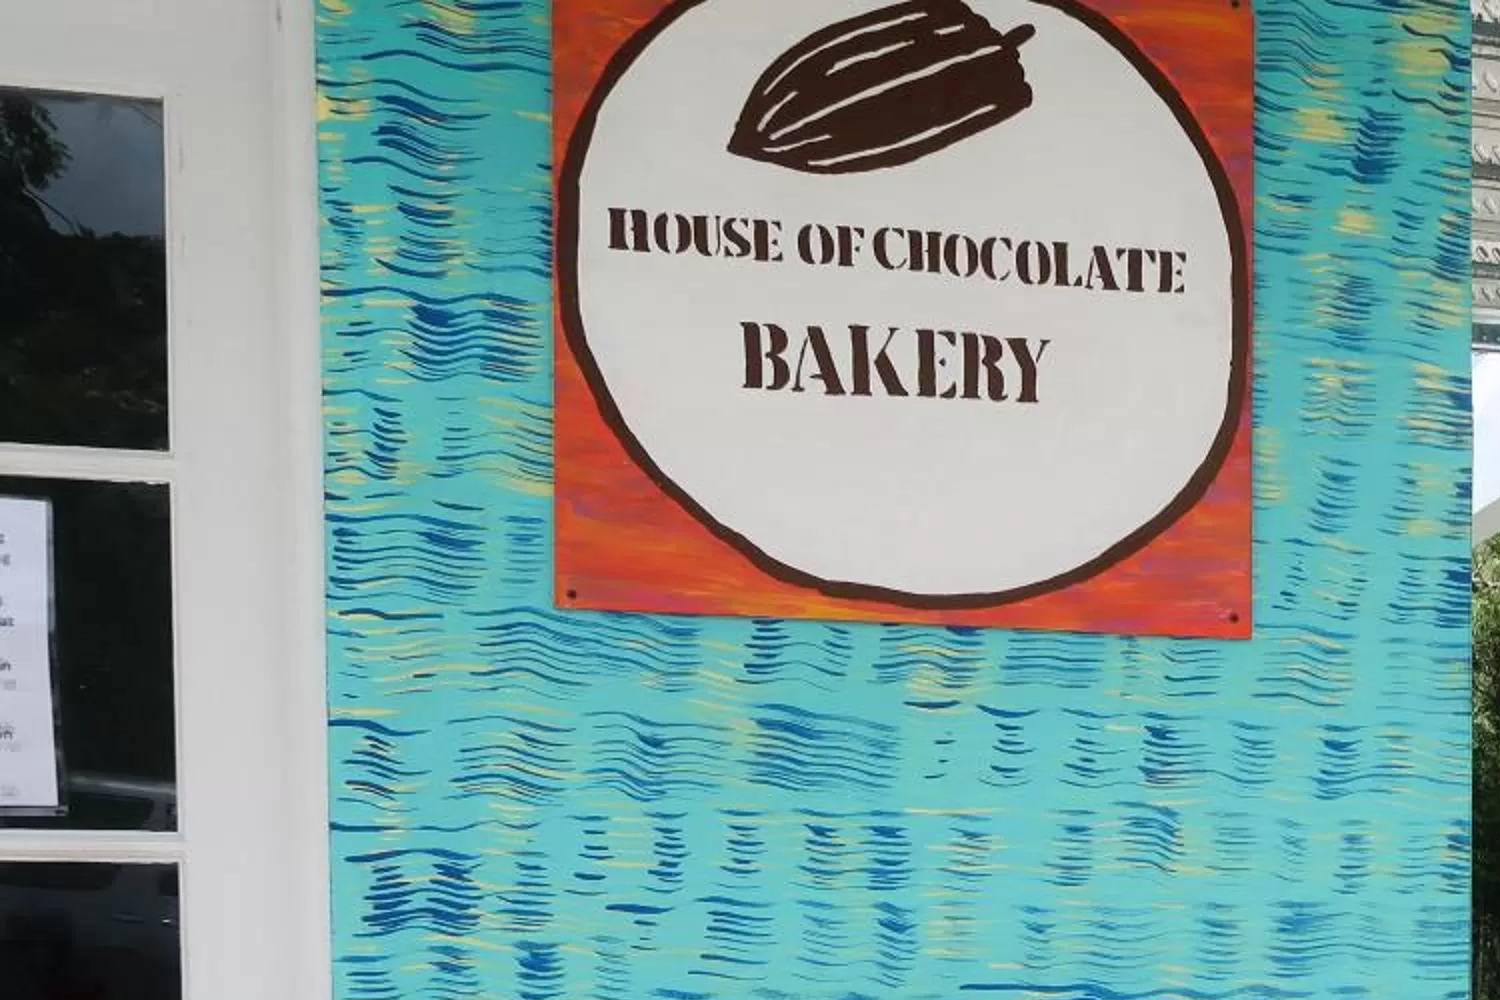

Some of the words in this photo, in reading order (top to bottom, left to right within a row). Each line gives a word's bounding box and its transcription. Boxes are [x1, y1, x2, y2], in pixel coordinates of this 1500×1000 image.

[607, 206, 784, 263] HOUSE
[797, 223, 866, 269] OF
[873, 226, 1188, 295] CHOCOLATE
[739, 320, 1051, 404] BAKERY
